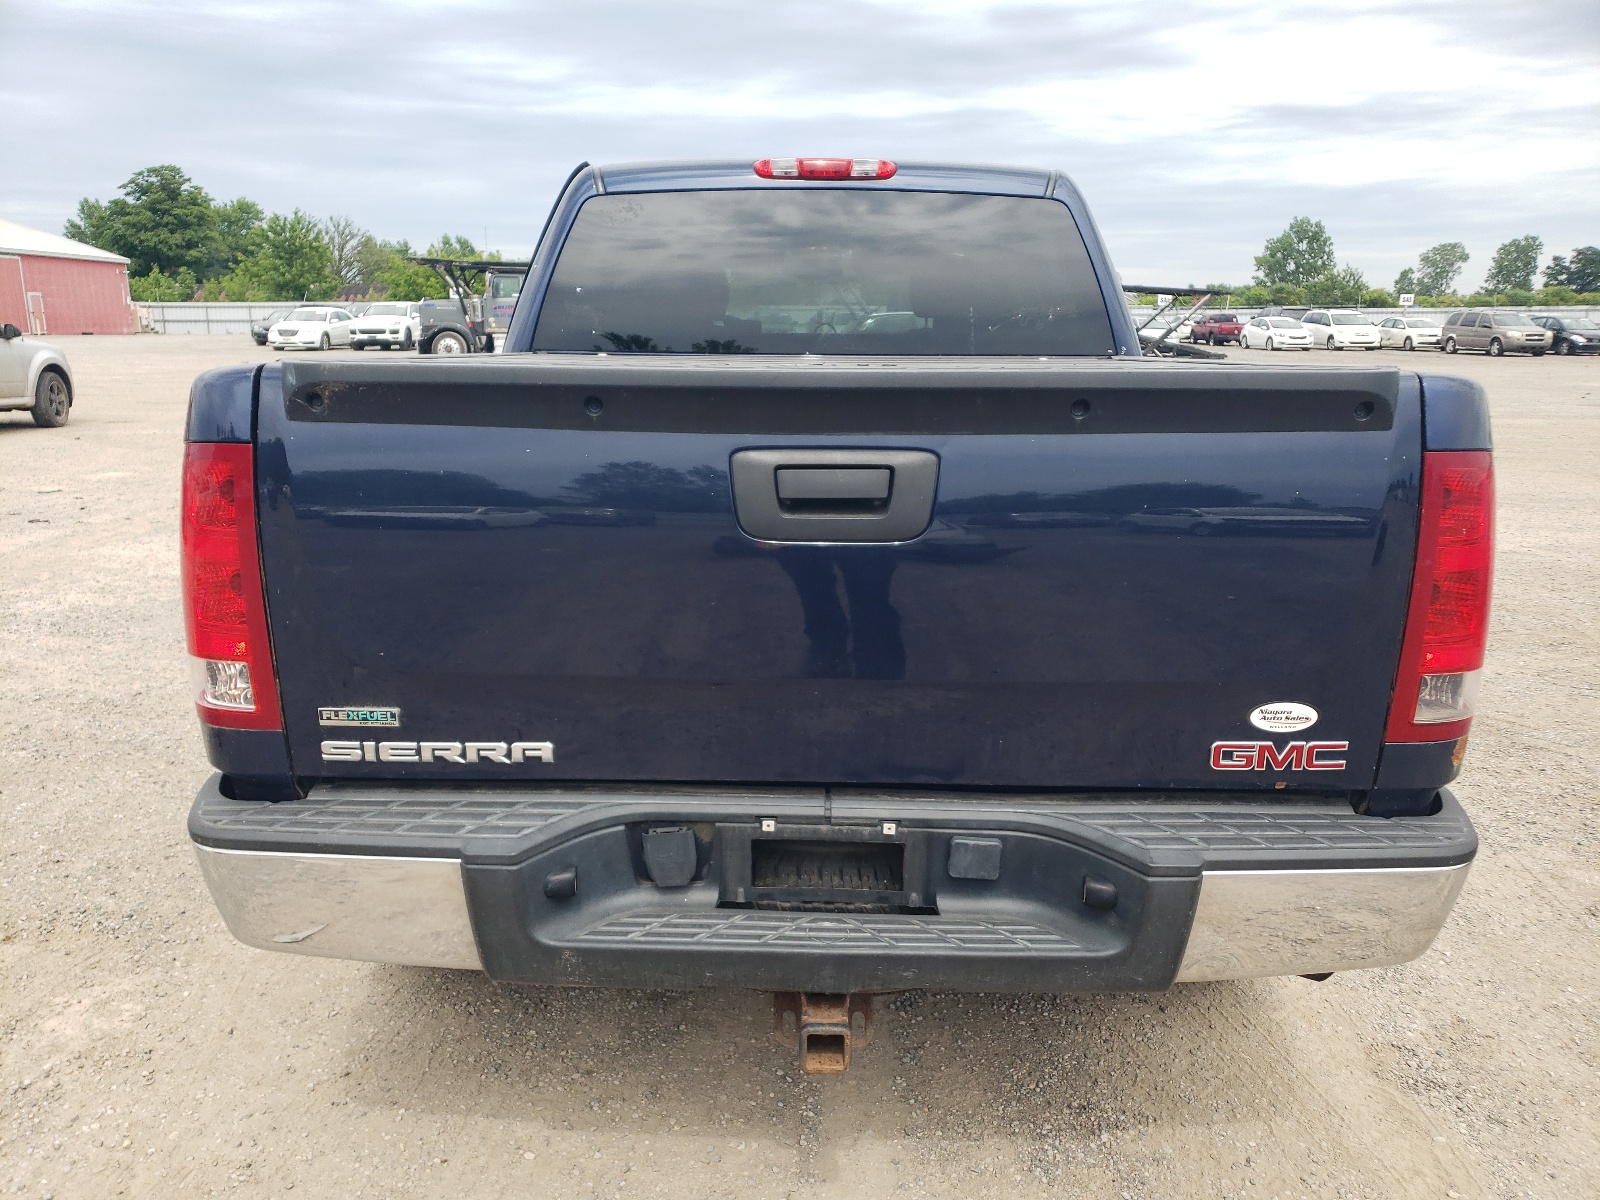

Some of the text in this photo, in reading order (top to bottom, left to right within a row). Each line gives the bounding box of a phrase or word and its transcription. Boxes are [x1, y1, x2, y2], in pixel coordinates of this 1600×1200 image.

[321, 710, 396, 721] FLEXFUEL
[320, 741, 554, 764] SIERRA
[1210, 741, 1349, 771] GMC
